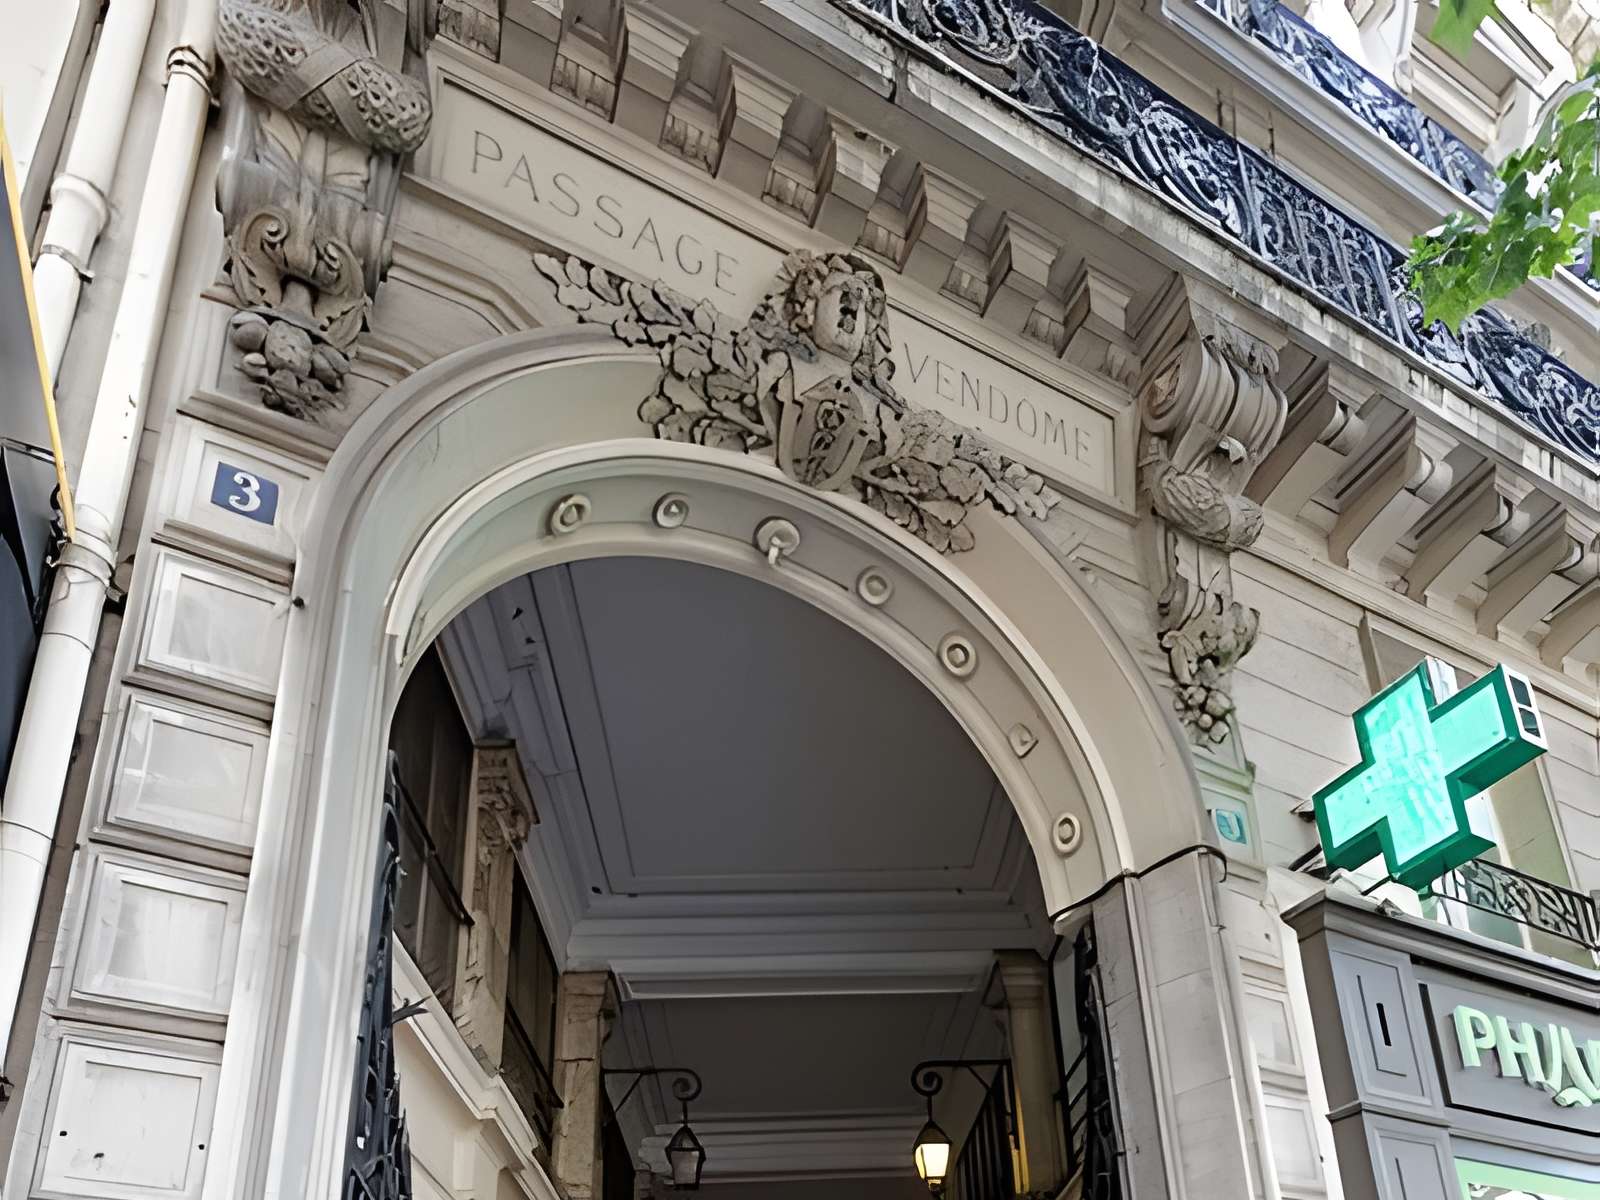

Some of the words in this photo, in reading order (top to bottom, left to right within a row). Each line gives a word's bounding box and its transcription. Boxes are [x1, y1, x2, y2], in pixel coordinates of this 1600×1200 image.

[471, 129, 740, 297] PASSAGE
[903, 341, 1093, 469] VENDOME
[228, 471, 261, 512] 3
